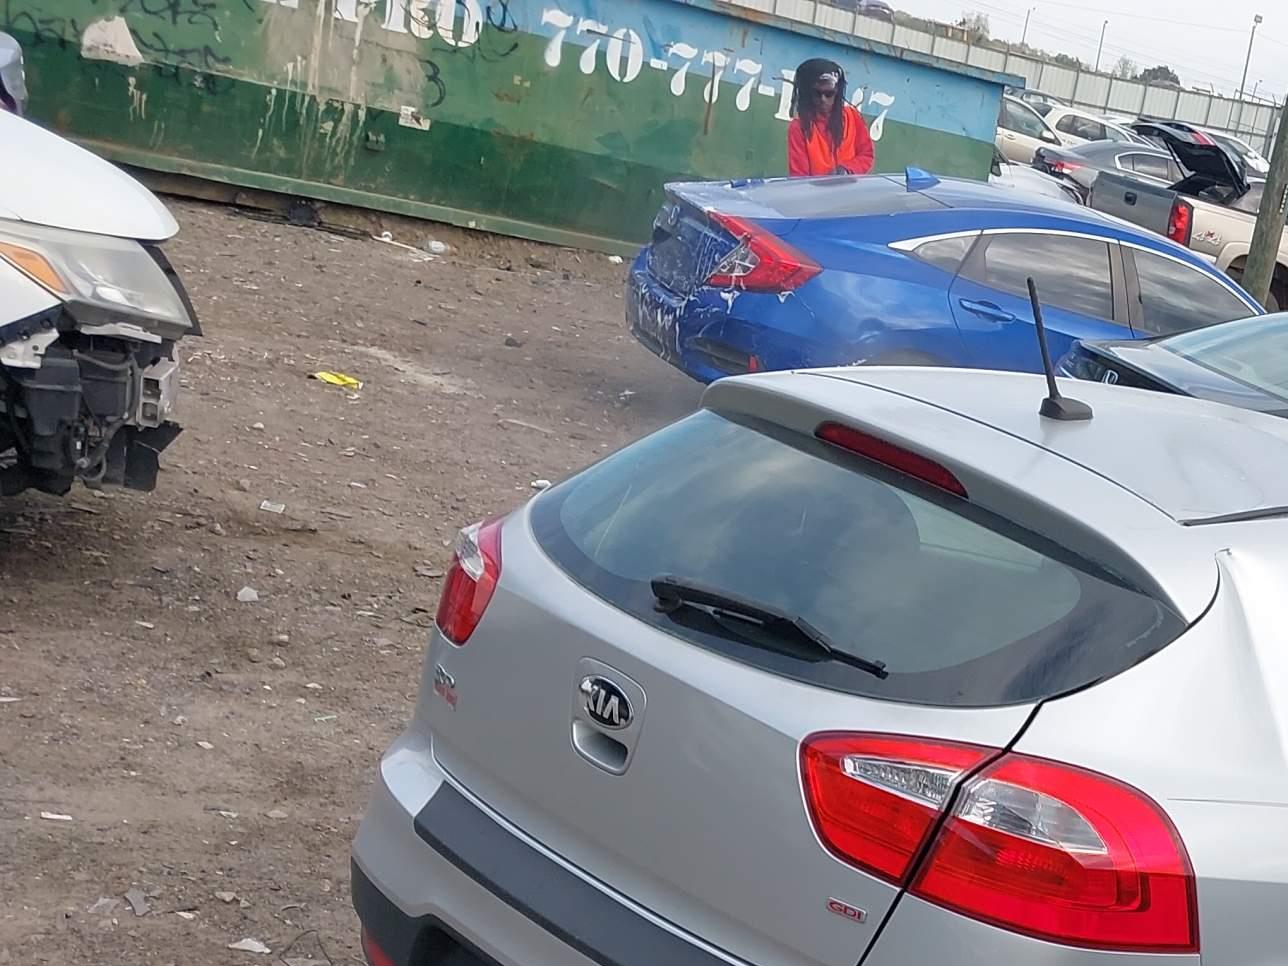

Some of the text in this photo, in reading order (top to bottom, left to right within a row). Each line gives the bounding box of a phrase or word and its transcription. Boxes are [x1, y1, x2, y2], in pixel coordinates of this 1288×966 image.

[541, 8, 896, 142] 770-777-17
[582, 679, 621, 725] KIA
[828, 901, 862, 921] GDI
